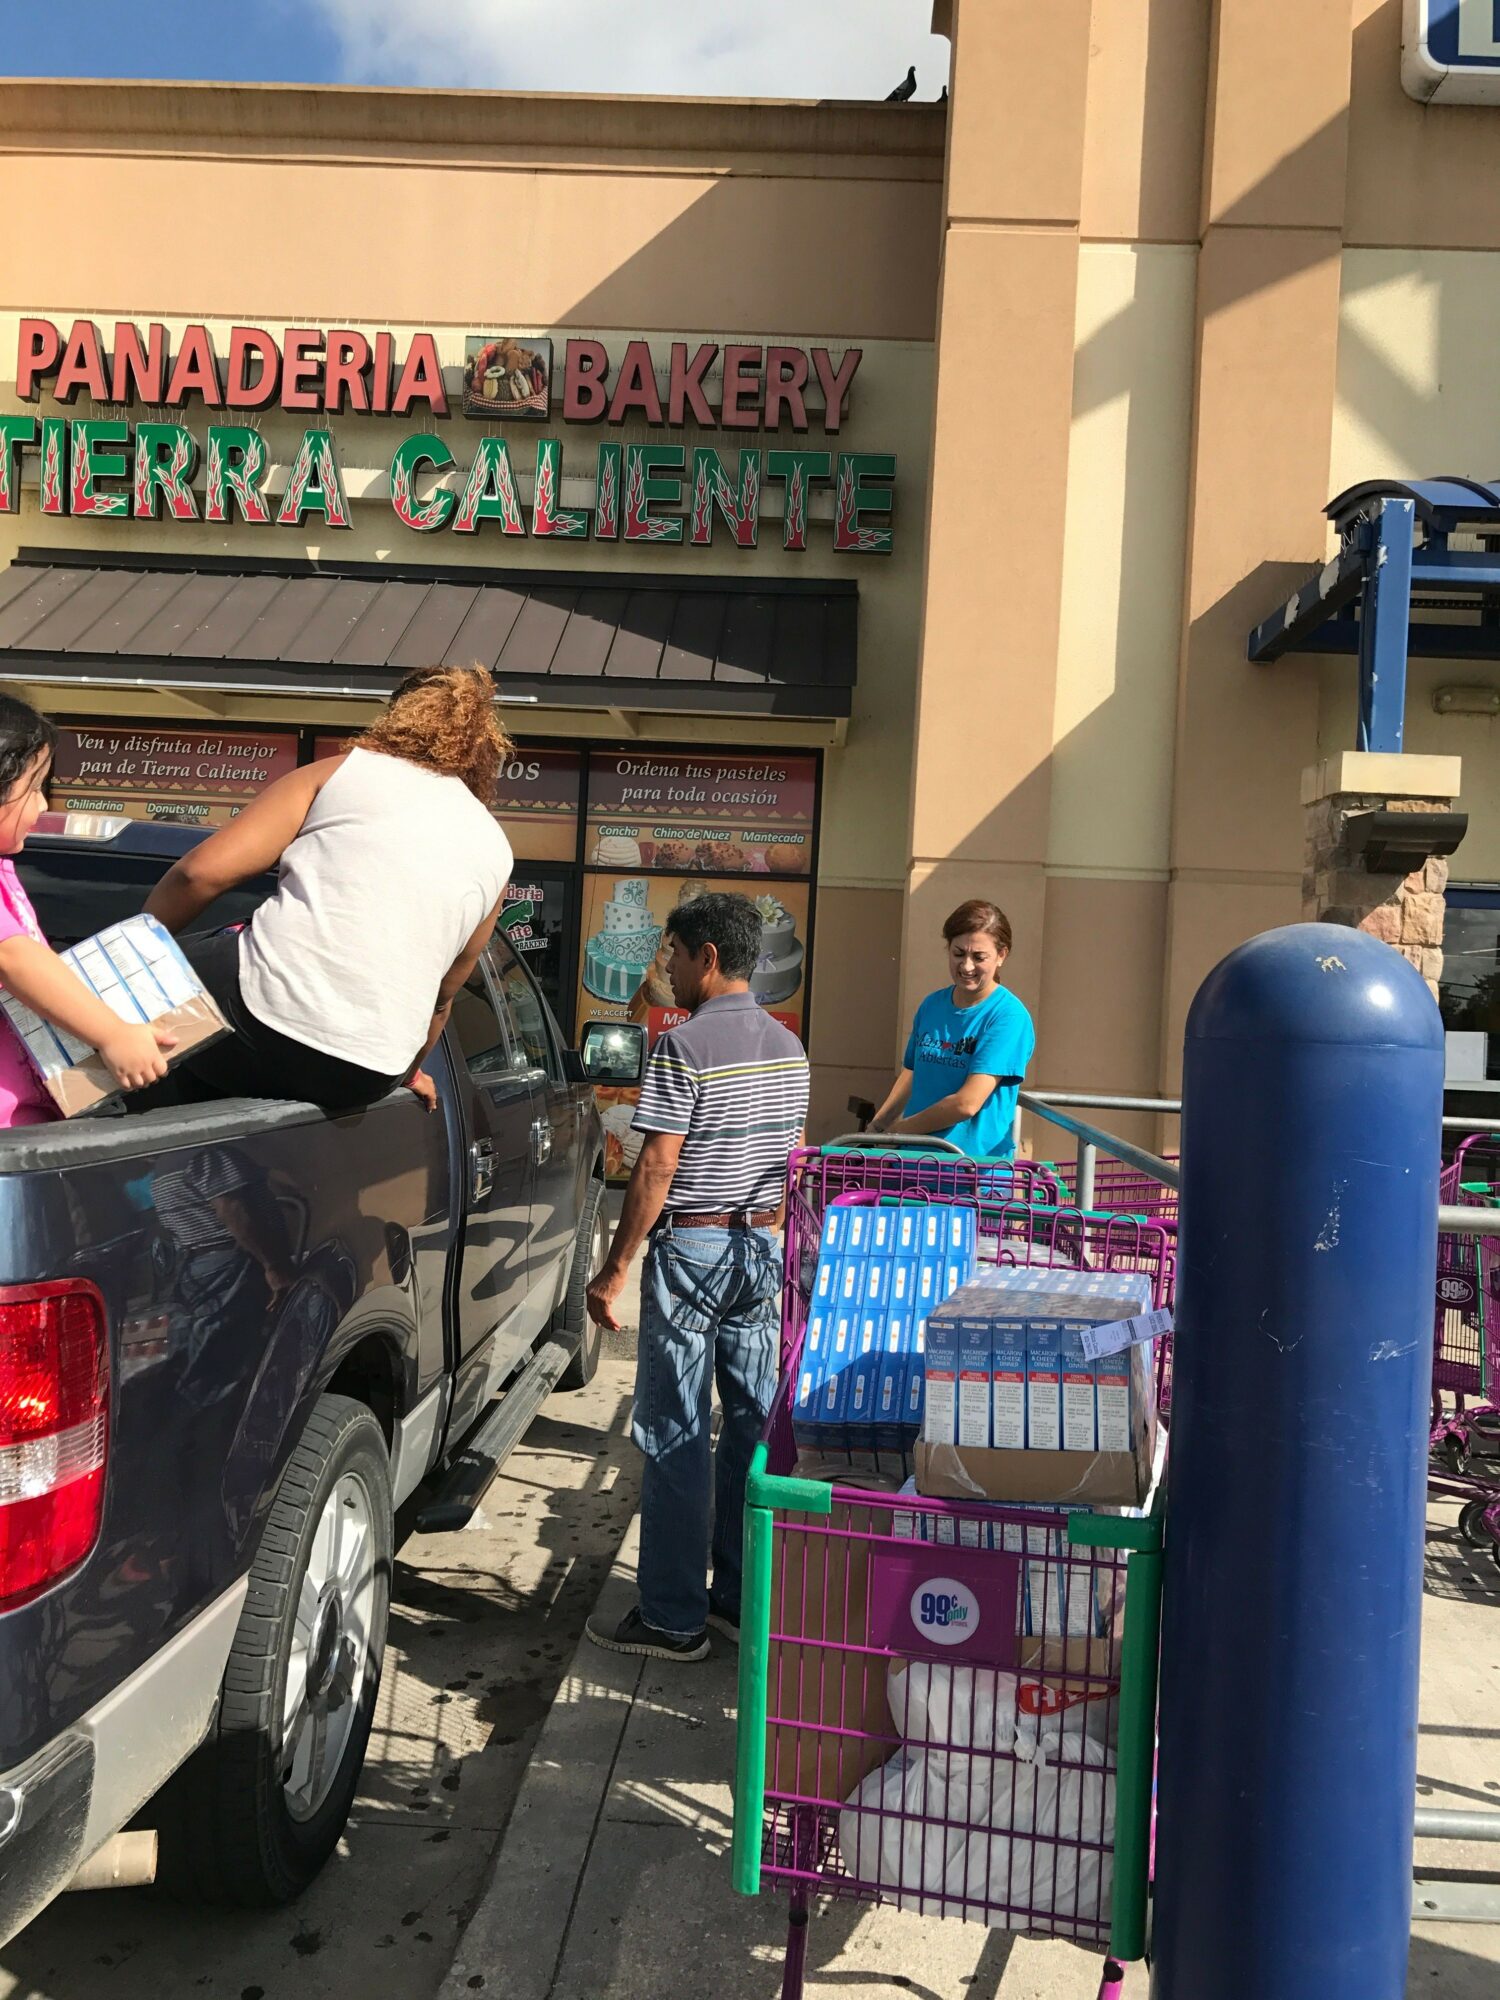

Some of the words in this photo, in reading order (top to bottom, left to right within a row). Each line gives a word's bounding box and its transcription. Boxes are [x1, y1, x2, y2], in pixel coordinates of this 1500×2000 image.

[16, 317, 450, 419] PANADERIA
[563, 338, 863, 434] BAKERY
[0, 415, 353, 529] TIERRA
[390, 432, 897, 553] CALIENTE
[75, 733, 105, 750] Ven
[108, 738, 120, 755] y
[124, 735, 192, 756] disfruta
[196, 739, 222, 756] del
[227, 743, 278, 762] mejor
[78, 761, 112, 777] pan
[116, 759, 136, 775] de
[140, 760, 191, 778] Tierra
[195, 763, 268, 781] Caliente
[616, 759, 680, 779] Ordena
[685, 765, 711, 780] tus
[715, 765, 787, 784] pasteles
[620, 787, 662, 803] para
[667, 786, 705, 802] toda
[711, 788, 778, 806] ocasión
[66, 799, 124, 811] Chilindrina
[147, 803, 185, 815] Donuts
[187, 805, 209, 816] Mix
[598, 825, 639, 837] Concha
[653, 827, 684, 839] Chino
[685, 828, 700, 840] de
[702, 829, 731, 841] Nuez
[741, 831, 805, 844] Mantecada
[519, 939, 548, 950] BAKERY
[590, 1008, 602, 1016] WE
[603, 1009, 633, 1018] ACCEPT
[921, 1593, 958, 1626] 99¢
[947, 1606, 968, 1622] only
